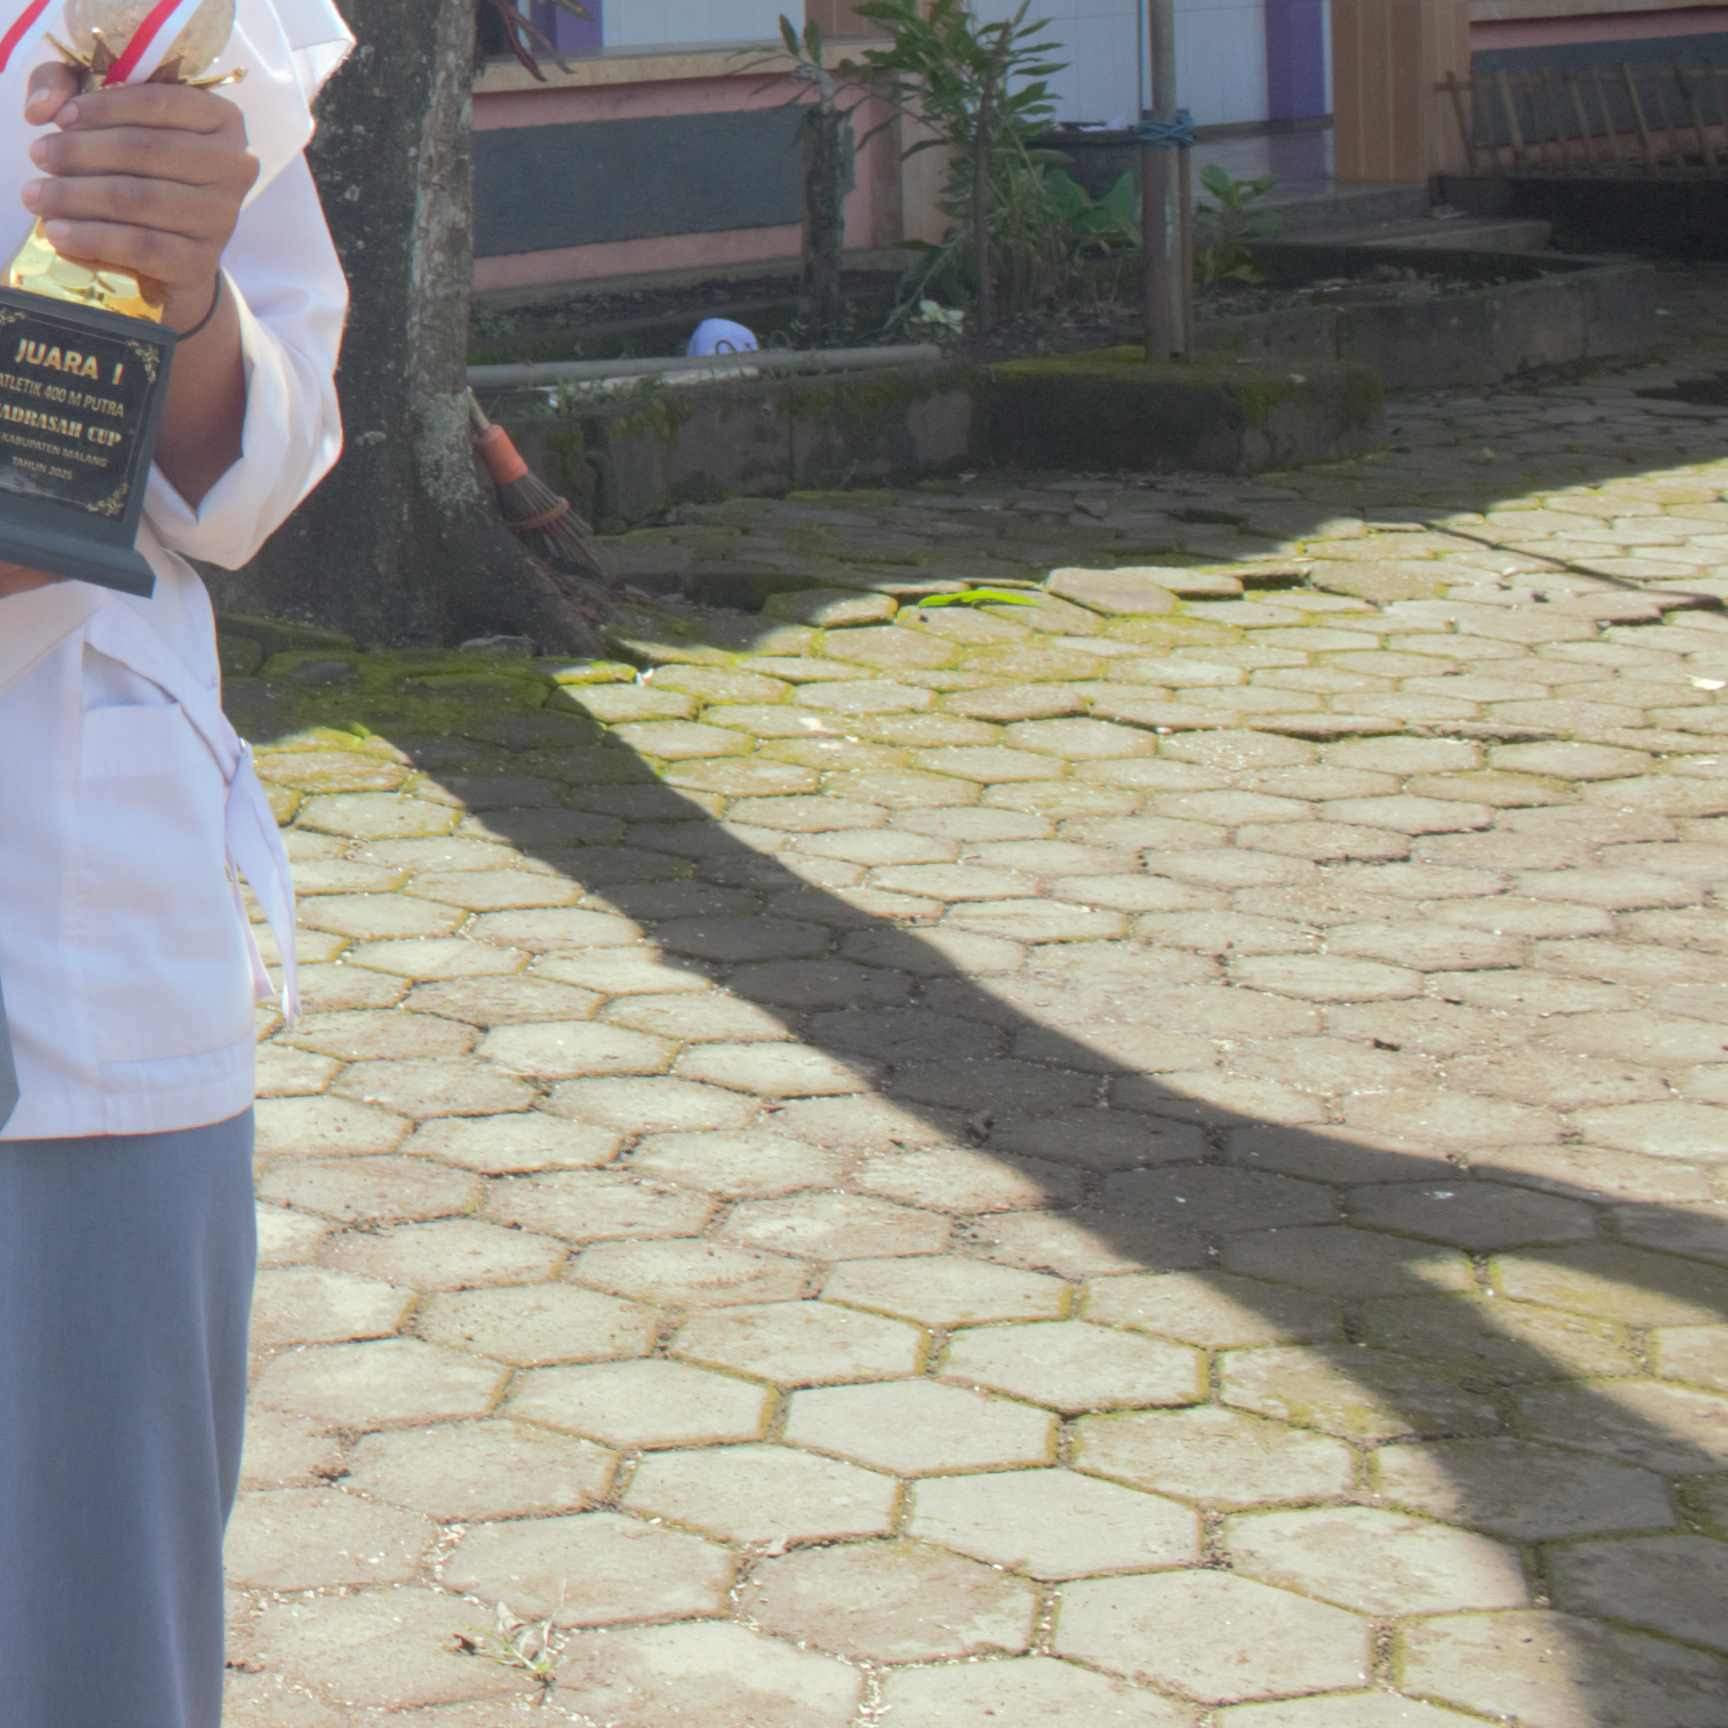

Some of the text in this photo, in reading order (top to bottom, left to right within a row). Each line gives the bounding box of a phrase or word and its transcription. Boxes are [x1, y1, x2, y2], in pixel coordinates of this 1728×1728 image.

[14, 337, 124, 385] JUARA I
[68, 391, 82, 406] M
[84, 394, 125, 417] PUTRA
[1, 432, 61, 455] KABUPATEN
[62, 448, 109, 468] MALANG
[86, 426, 122, 447] CUP
